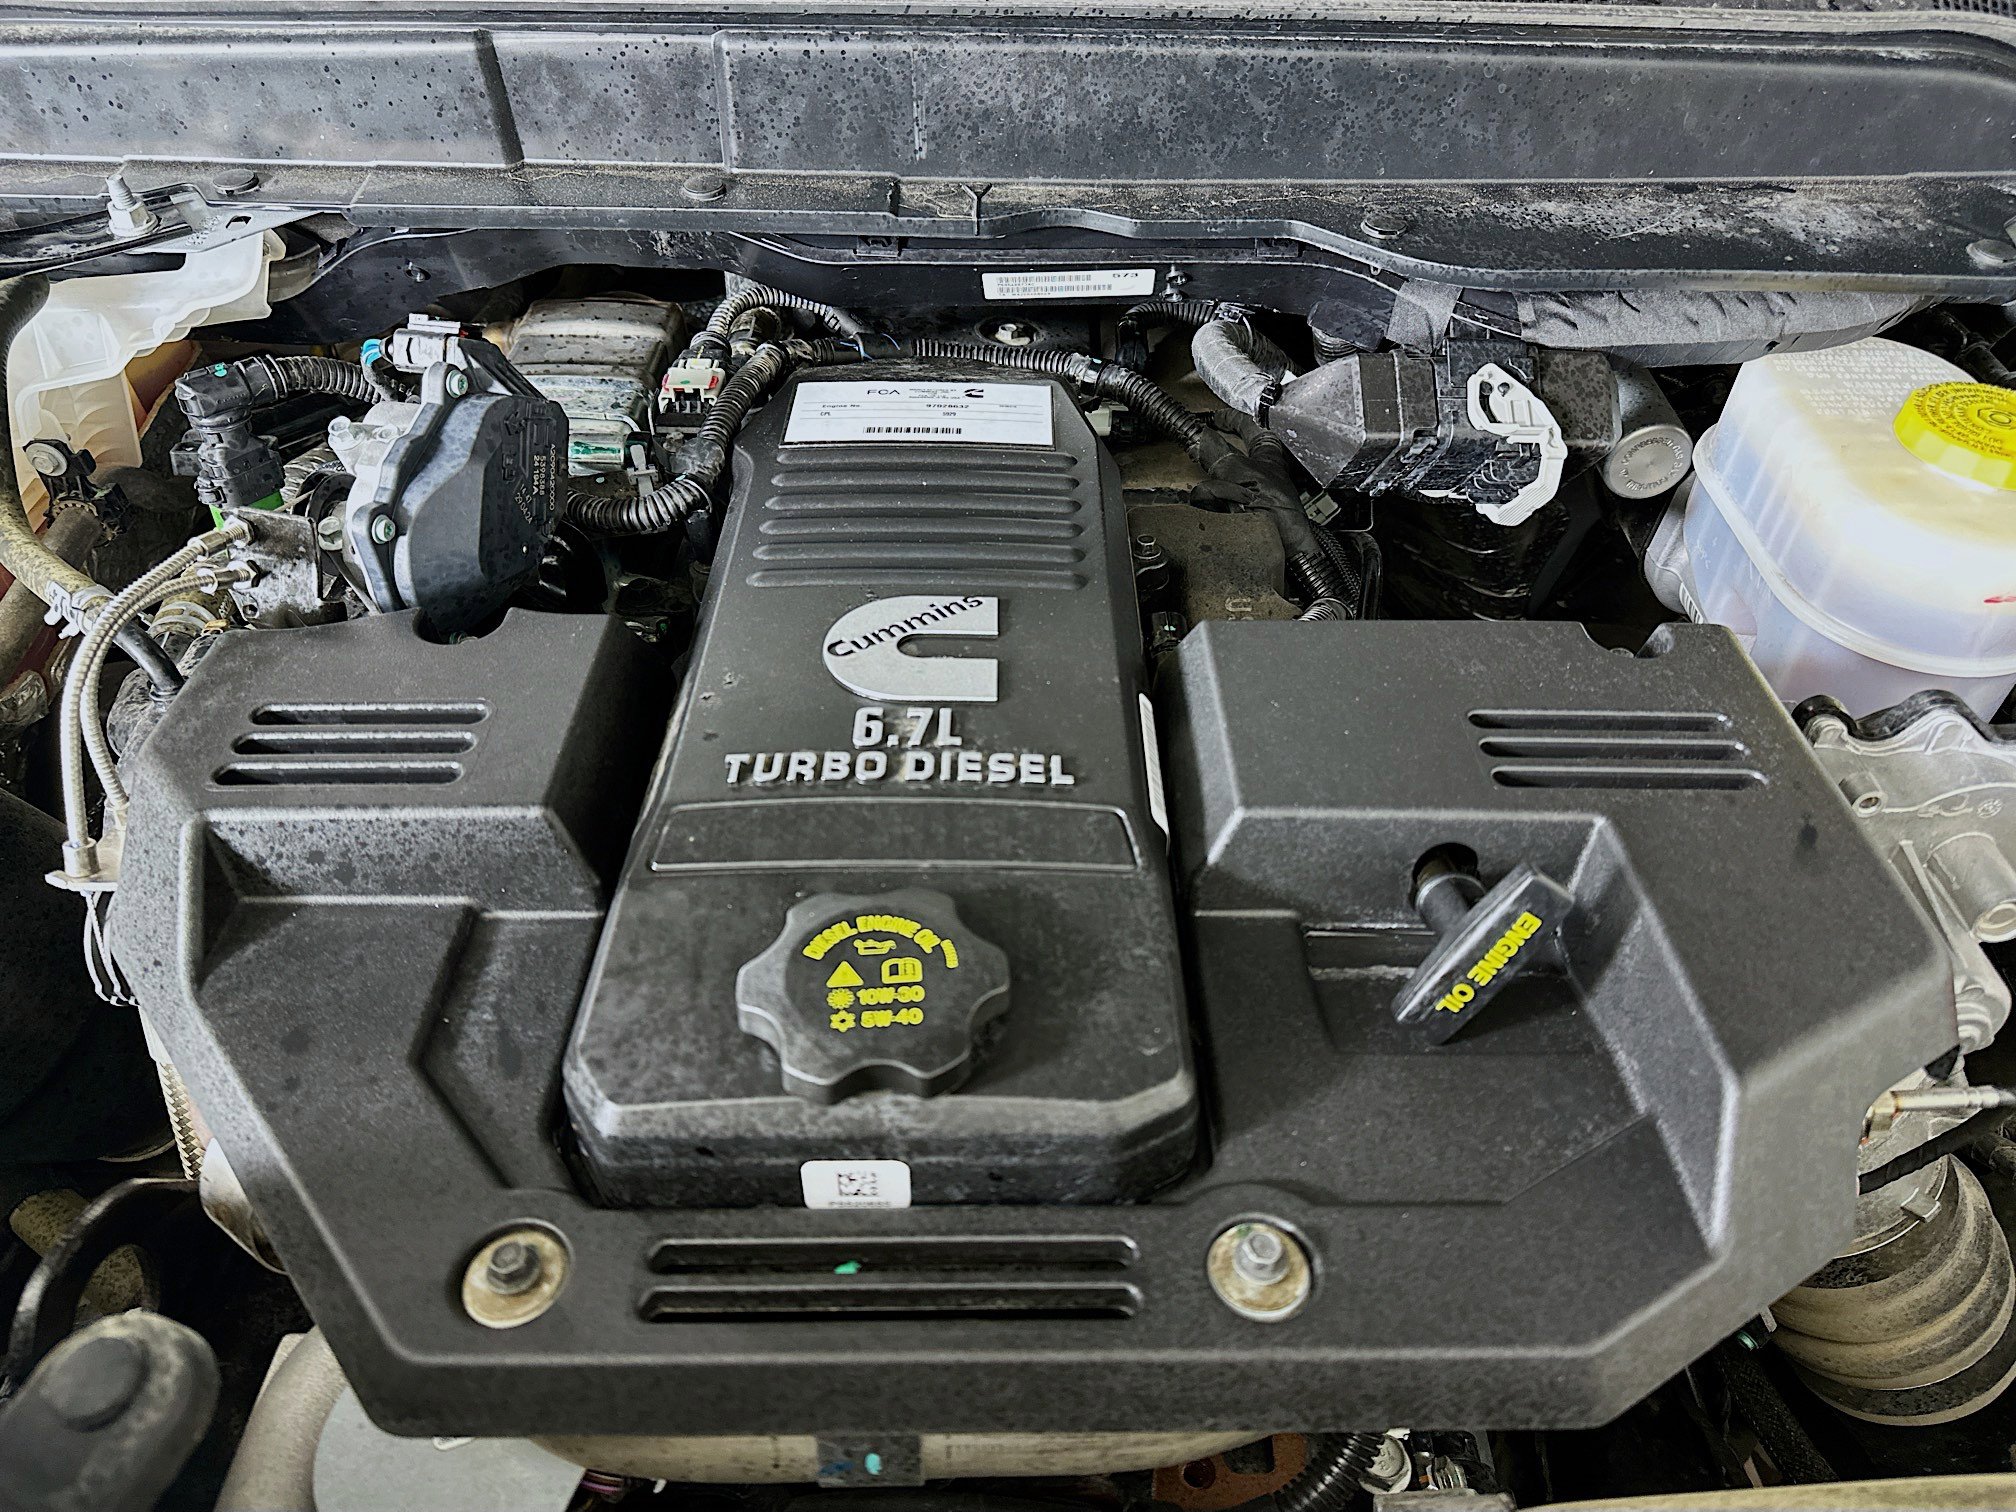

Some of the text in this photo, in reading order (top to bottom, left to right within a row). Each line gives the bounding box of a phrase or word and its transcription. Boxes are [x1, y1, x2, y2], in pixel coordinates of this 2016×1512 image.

[826, 595, 985, 658] Cummins
[852, 706, 963, 749] 6.7L
[724, 751, 1076, 787] TURBO DIESEL
[1435, 911, 1543, 1014] ENGINE OIL
